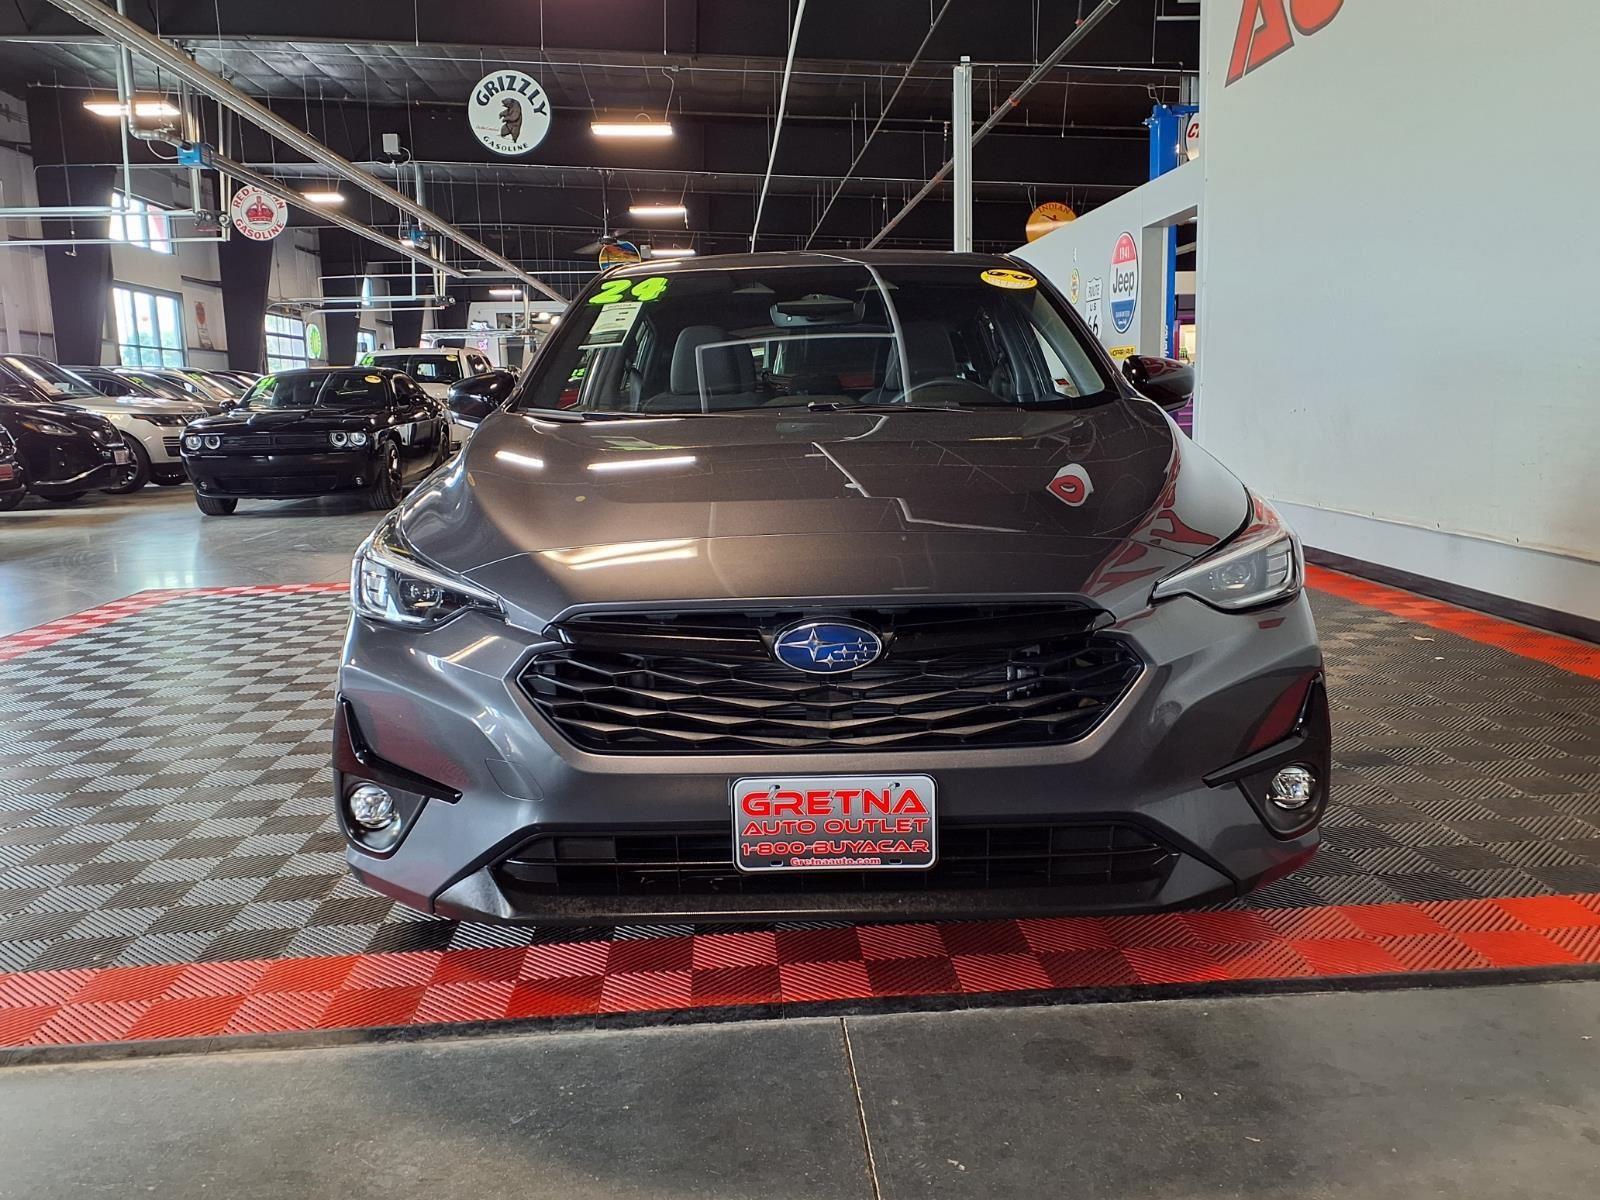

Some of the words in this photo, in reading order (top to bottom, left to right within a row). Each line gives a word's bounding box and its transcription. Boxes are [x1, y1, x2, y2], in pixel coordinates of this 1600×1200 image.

[476, 75, 547, 116] GRIZZLY
[483, 136, 529, 151] GASOLINE
[233, 188, 250, 208] RED
[1039, 203, 1069, 214] INDIAN
[235, 218, 285, 239] GASOLINE
[588, 277, 668, 304] 24
[1112, 268, 1135, 296] Jeep
[741, 788, 929, 816] GRETNA
[742, 819, 816, 836] AUTO
[824, 818, 930, 834] OUTLET
[741, 840, 930, 856] 1-800-BUYACAR
[790, 857, 881, 866] Gretnaauto.com
